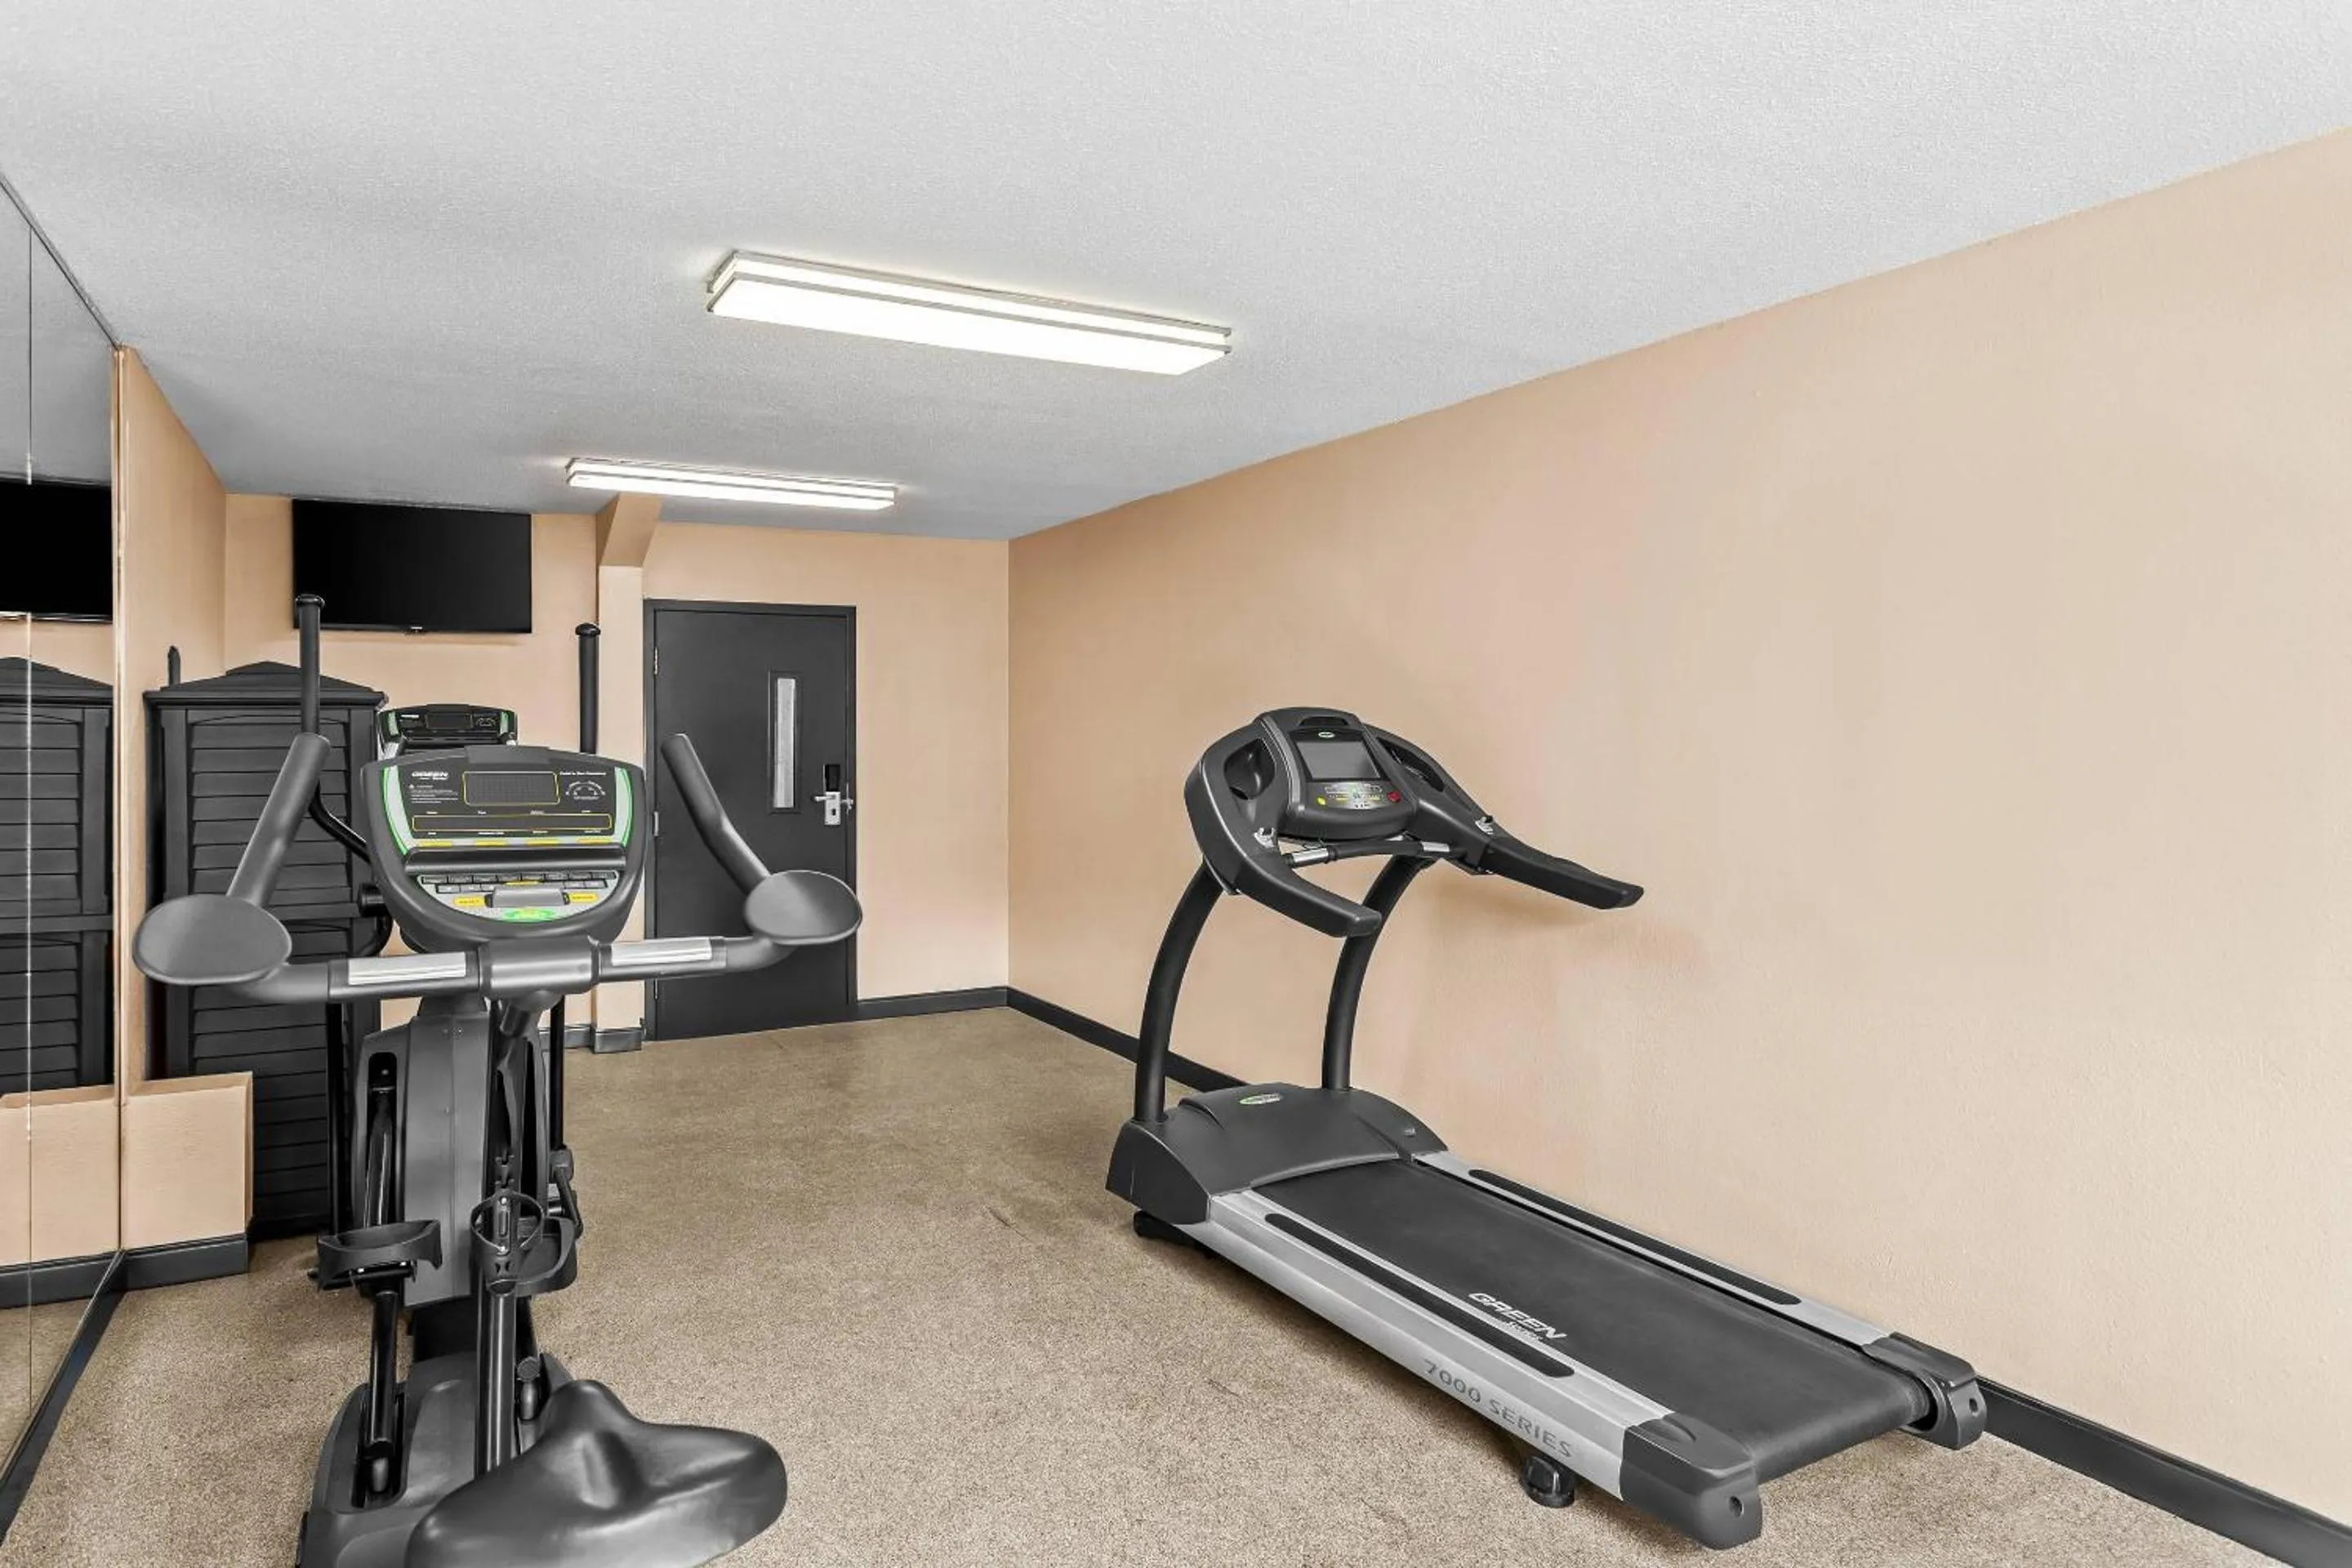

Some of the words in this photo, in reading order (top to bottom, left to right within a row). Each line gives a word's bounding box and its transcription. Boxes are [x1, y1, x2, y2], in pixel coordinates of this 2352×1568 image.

[1468, 1293, 1567, 1339] GREEN
[1423, 1358, 1481, 1403] 7000
[1489, 1397, 1573, 1458] SERIES
